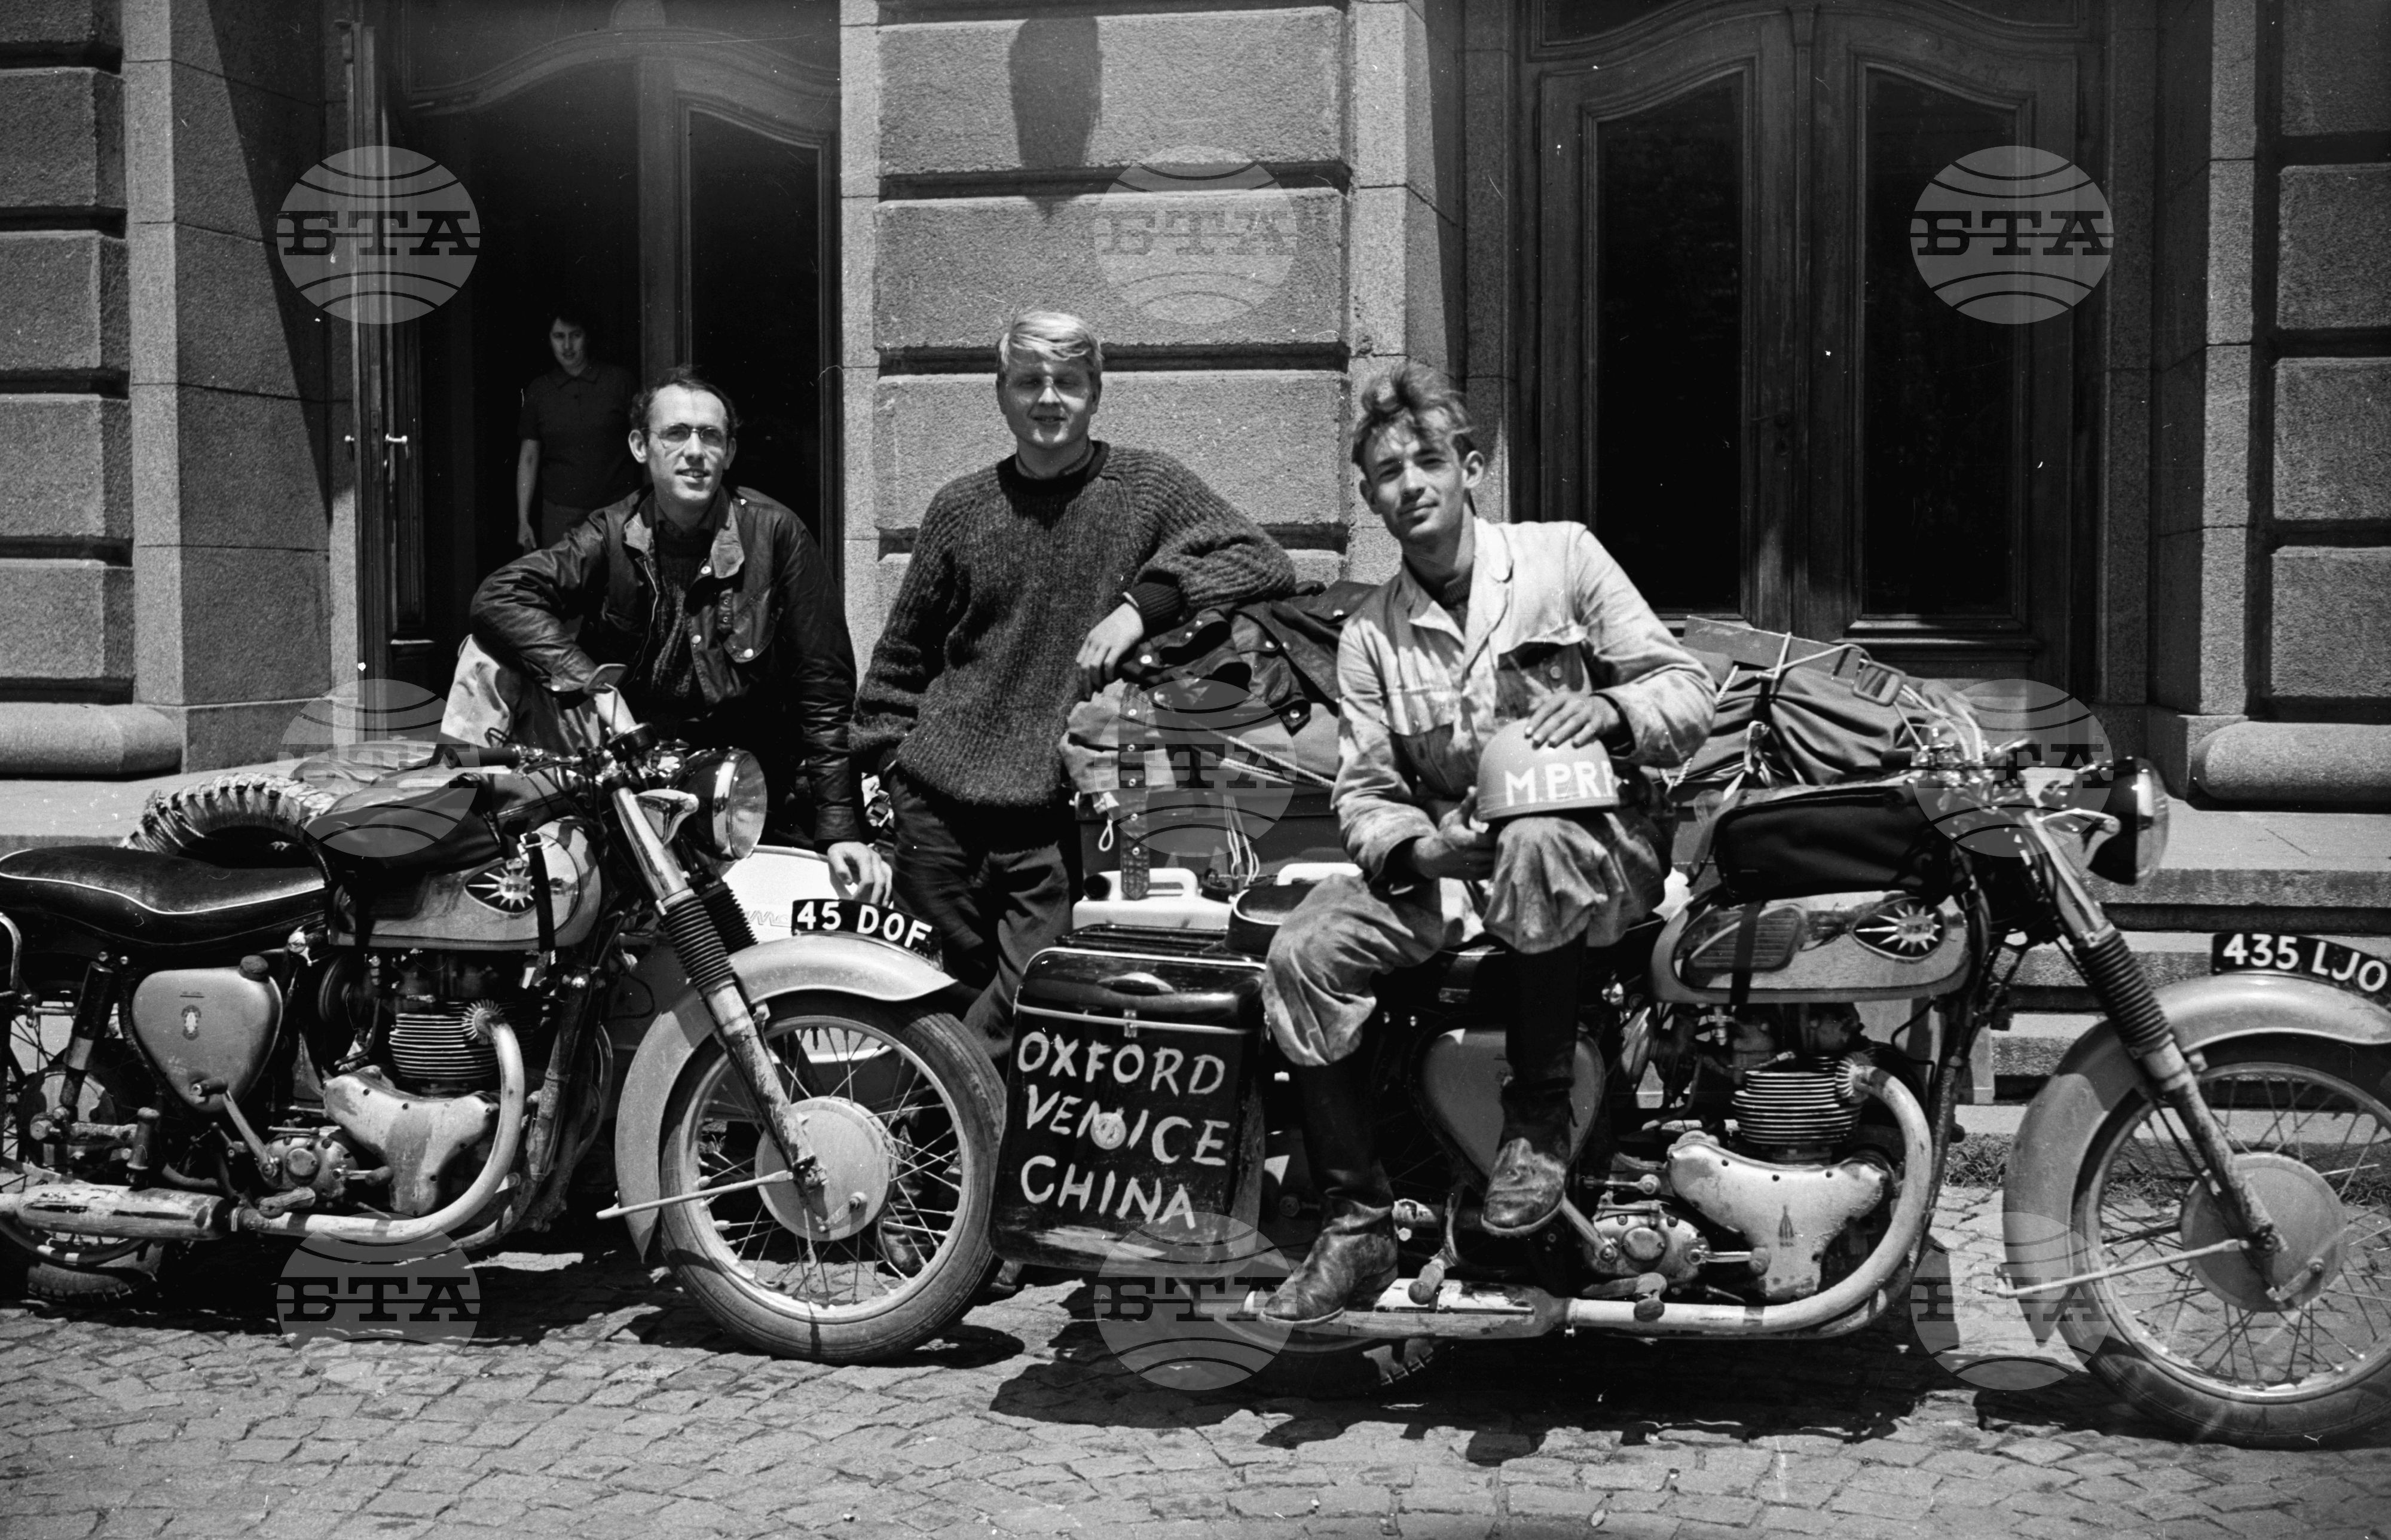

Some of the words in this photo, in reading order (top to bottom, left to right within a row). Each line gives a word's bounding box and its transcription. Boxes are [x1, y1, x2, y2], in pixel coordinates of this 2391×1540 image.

[797, 901, 842, 930] 45
[857, 905, 932, 948] DOF
[2223, 933, 2299, 970] 435
[2311, 941, 2387, 991] LJO
[1018, 1031, 1225, 1097] OXFORD
[1026, 1084, 1230, 1166] VENICE
[1020, 1155, 1196, 1229] CHINA
